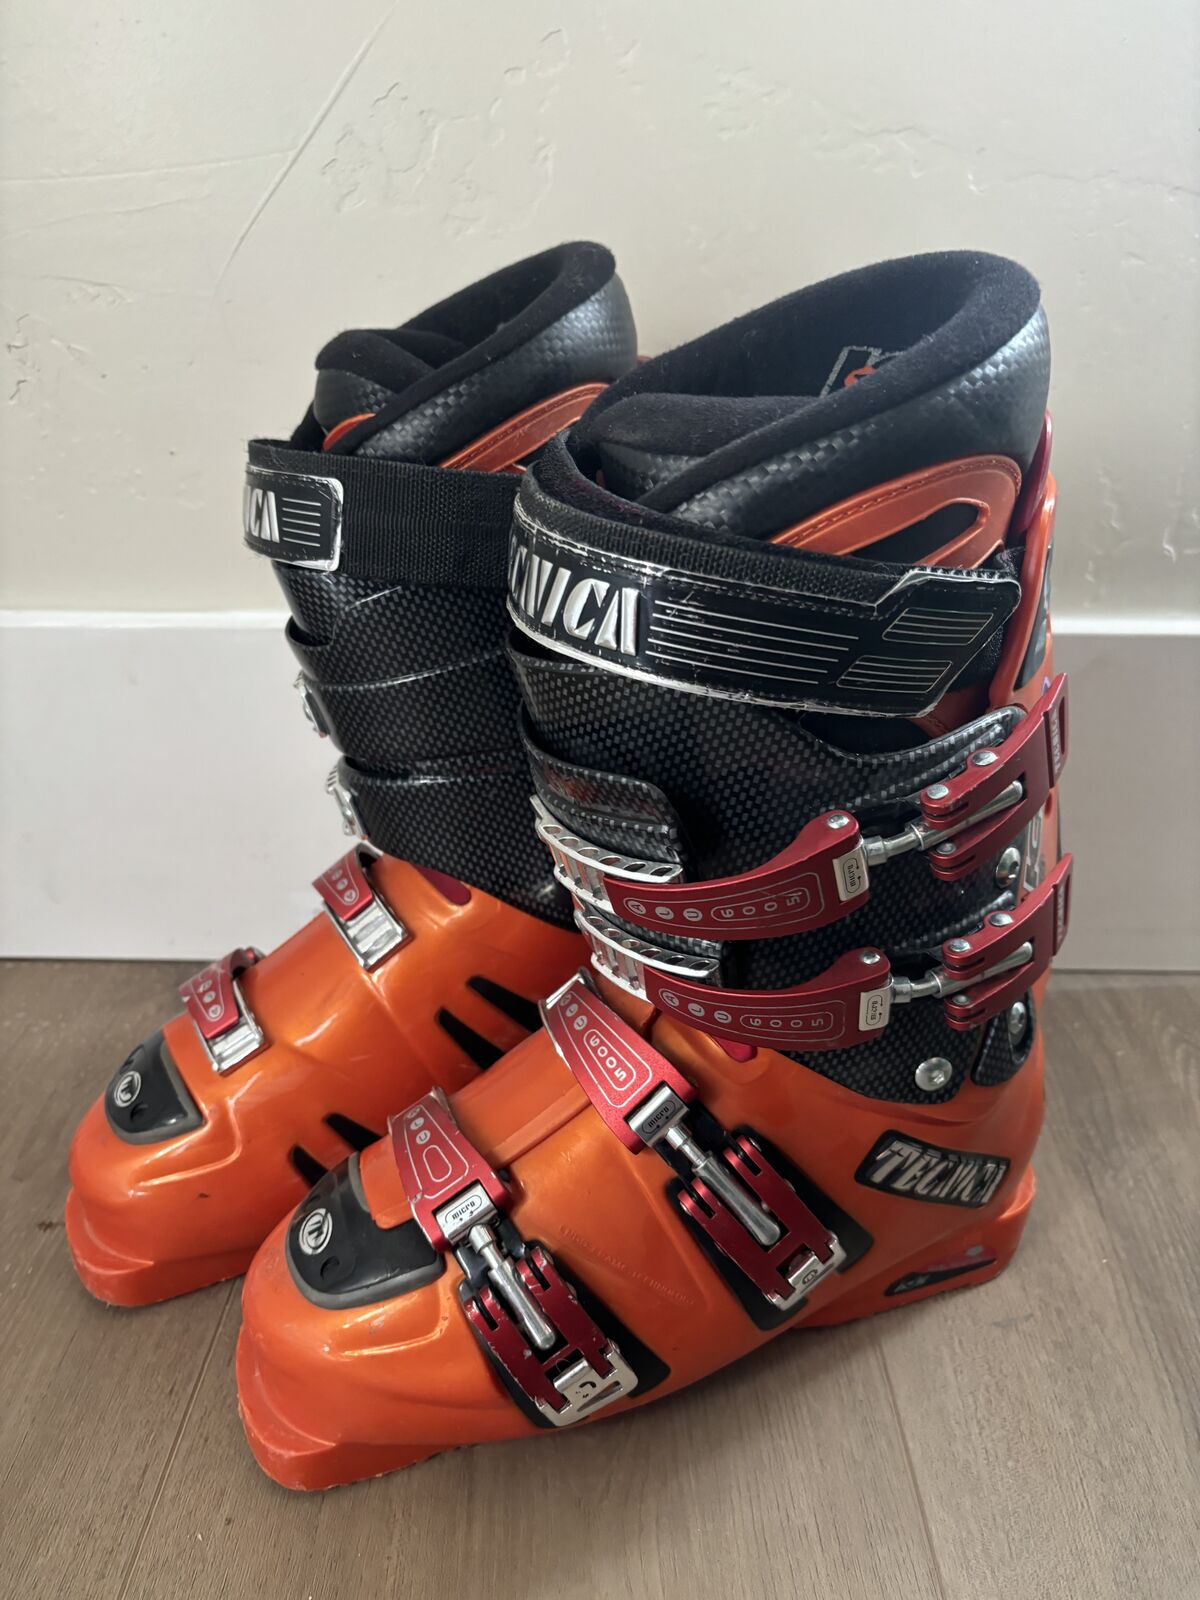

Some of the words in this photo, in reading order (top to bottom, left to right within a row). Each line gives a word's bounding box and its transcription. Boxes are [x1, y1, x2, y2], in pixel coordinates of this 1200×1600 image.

[848, 864, 856, 887] micro
[720, 895, 801, 919] 6005
[749, 1016, 824, 1028] 6005
[589, 1035, 627, 1082] 6005
[648, 1106, 670, 1128] micro
[452, 1199, 476, 1220] micro
